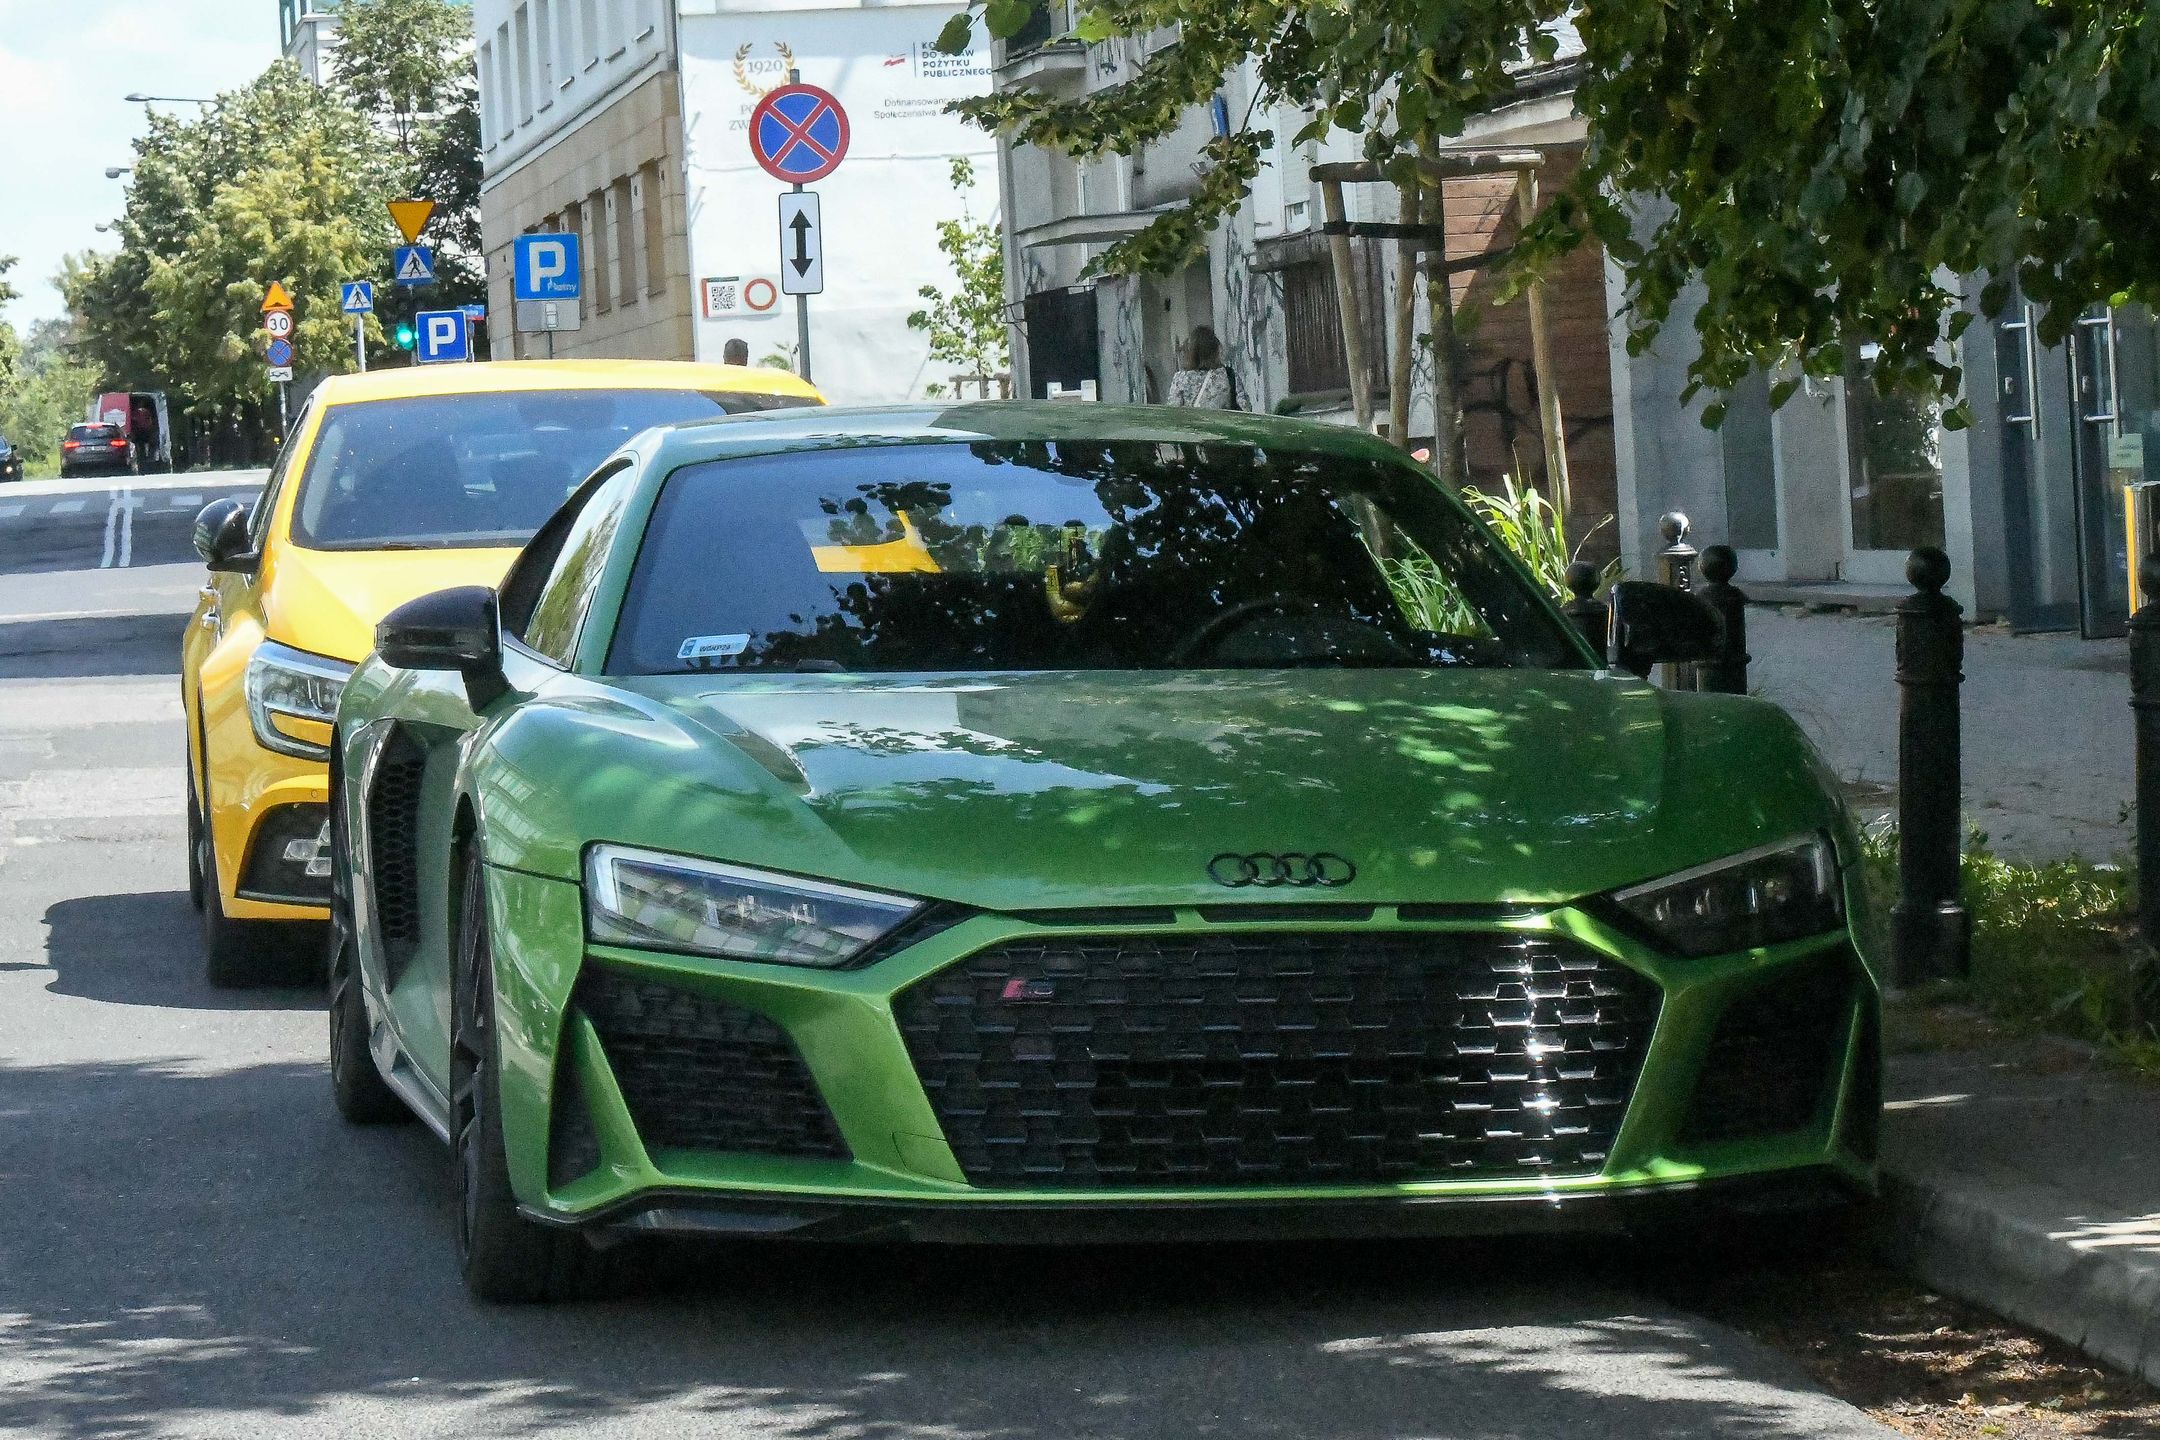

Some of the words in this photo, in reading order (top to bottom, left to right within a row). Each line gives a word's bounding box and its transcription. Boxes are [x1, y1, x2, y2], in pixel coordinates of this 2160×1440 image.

[922, 51, 937, 59] DO
[748, 60, 783, 75] 1920
[923, 59, 970, 68] POŻYTKU
[923, 68, 993, 77] PUBLICZNEGO
[529, 241, 566, 292] P
[269, 317, 288, 331] 30
[428, 317, 456, 356] P
